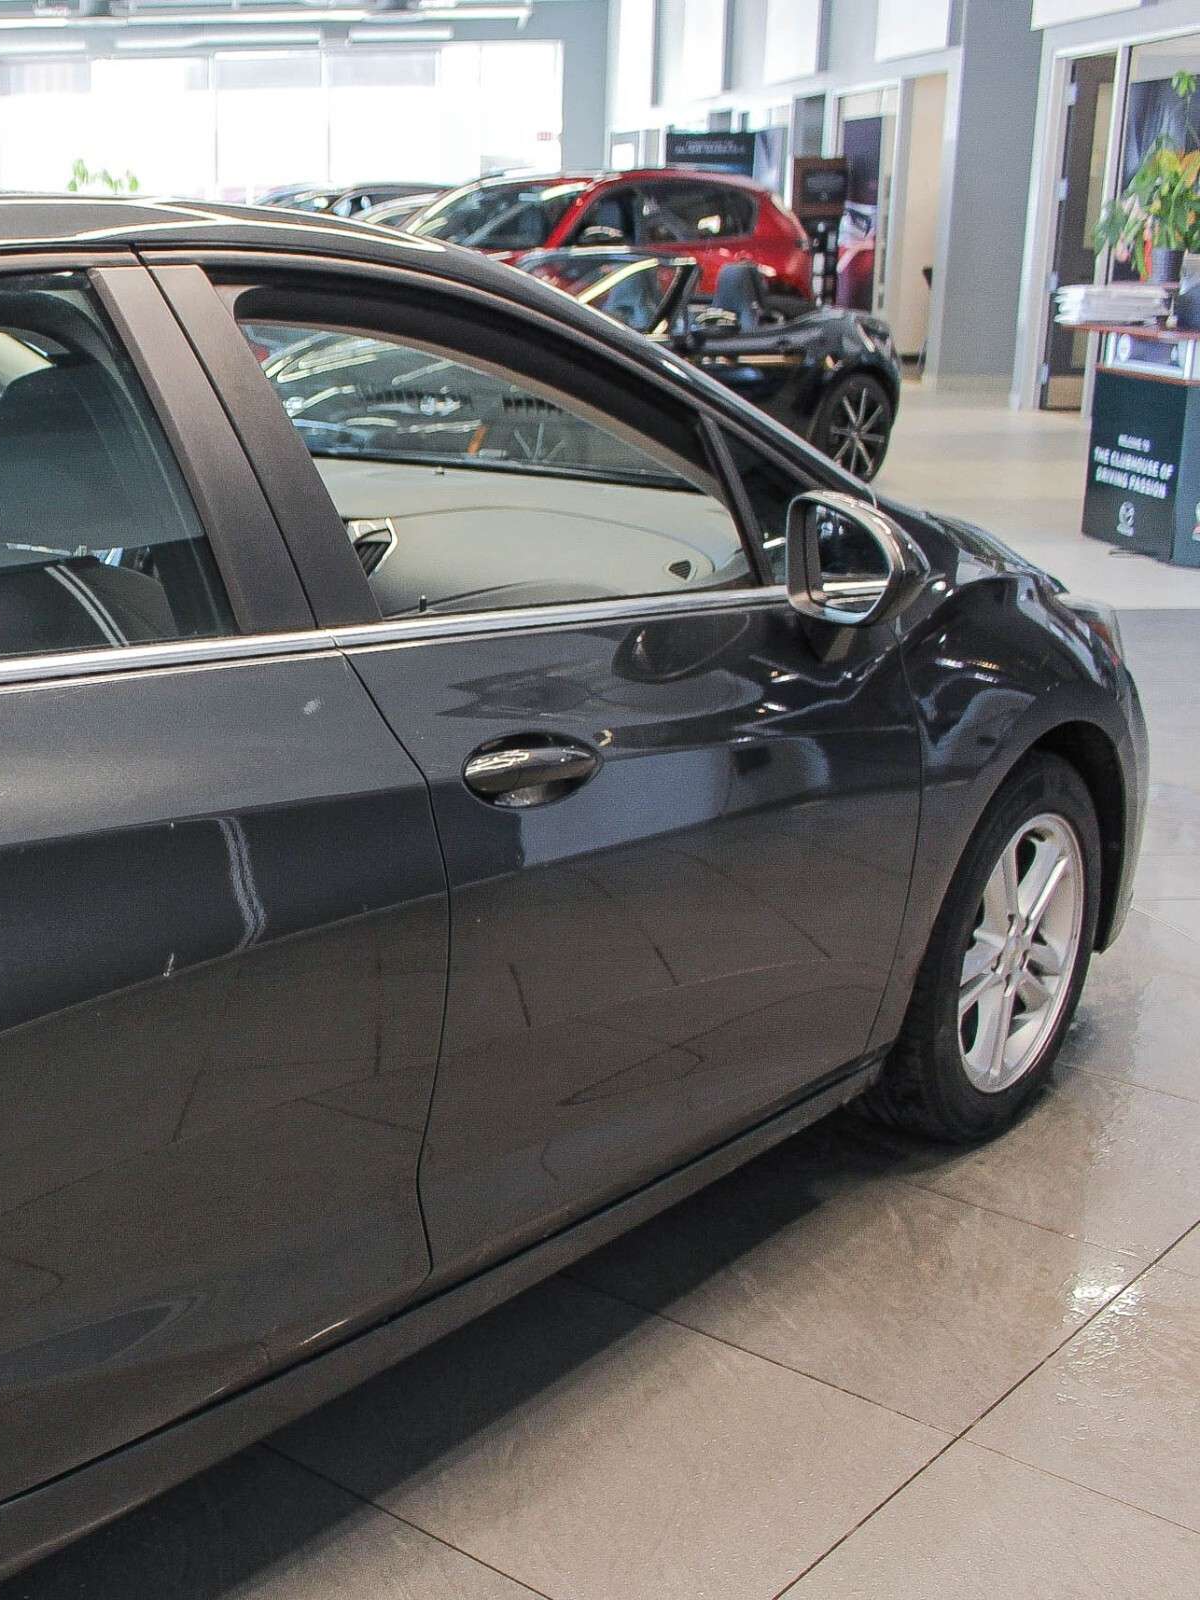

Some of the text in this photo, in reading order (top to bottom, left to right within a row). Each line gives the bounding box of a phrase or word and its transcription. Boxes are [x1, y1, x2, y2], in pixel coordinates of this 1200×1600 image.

[1094, 446, 1175, 480] THE CLUBHOUSE OF
[1096, 465, 1167, 499] DRIVING PASSION
